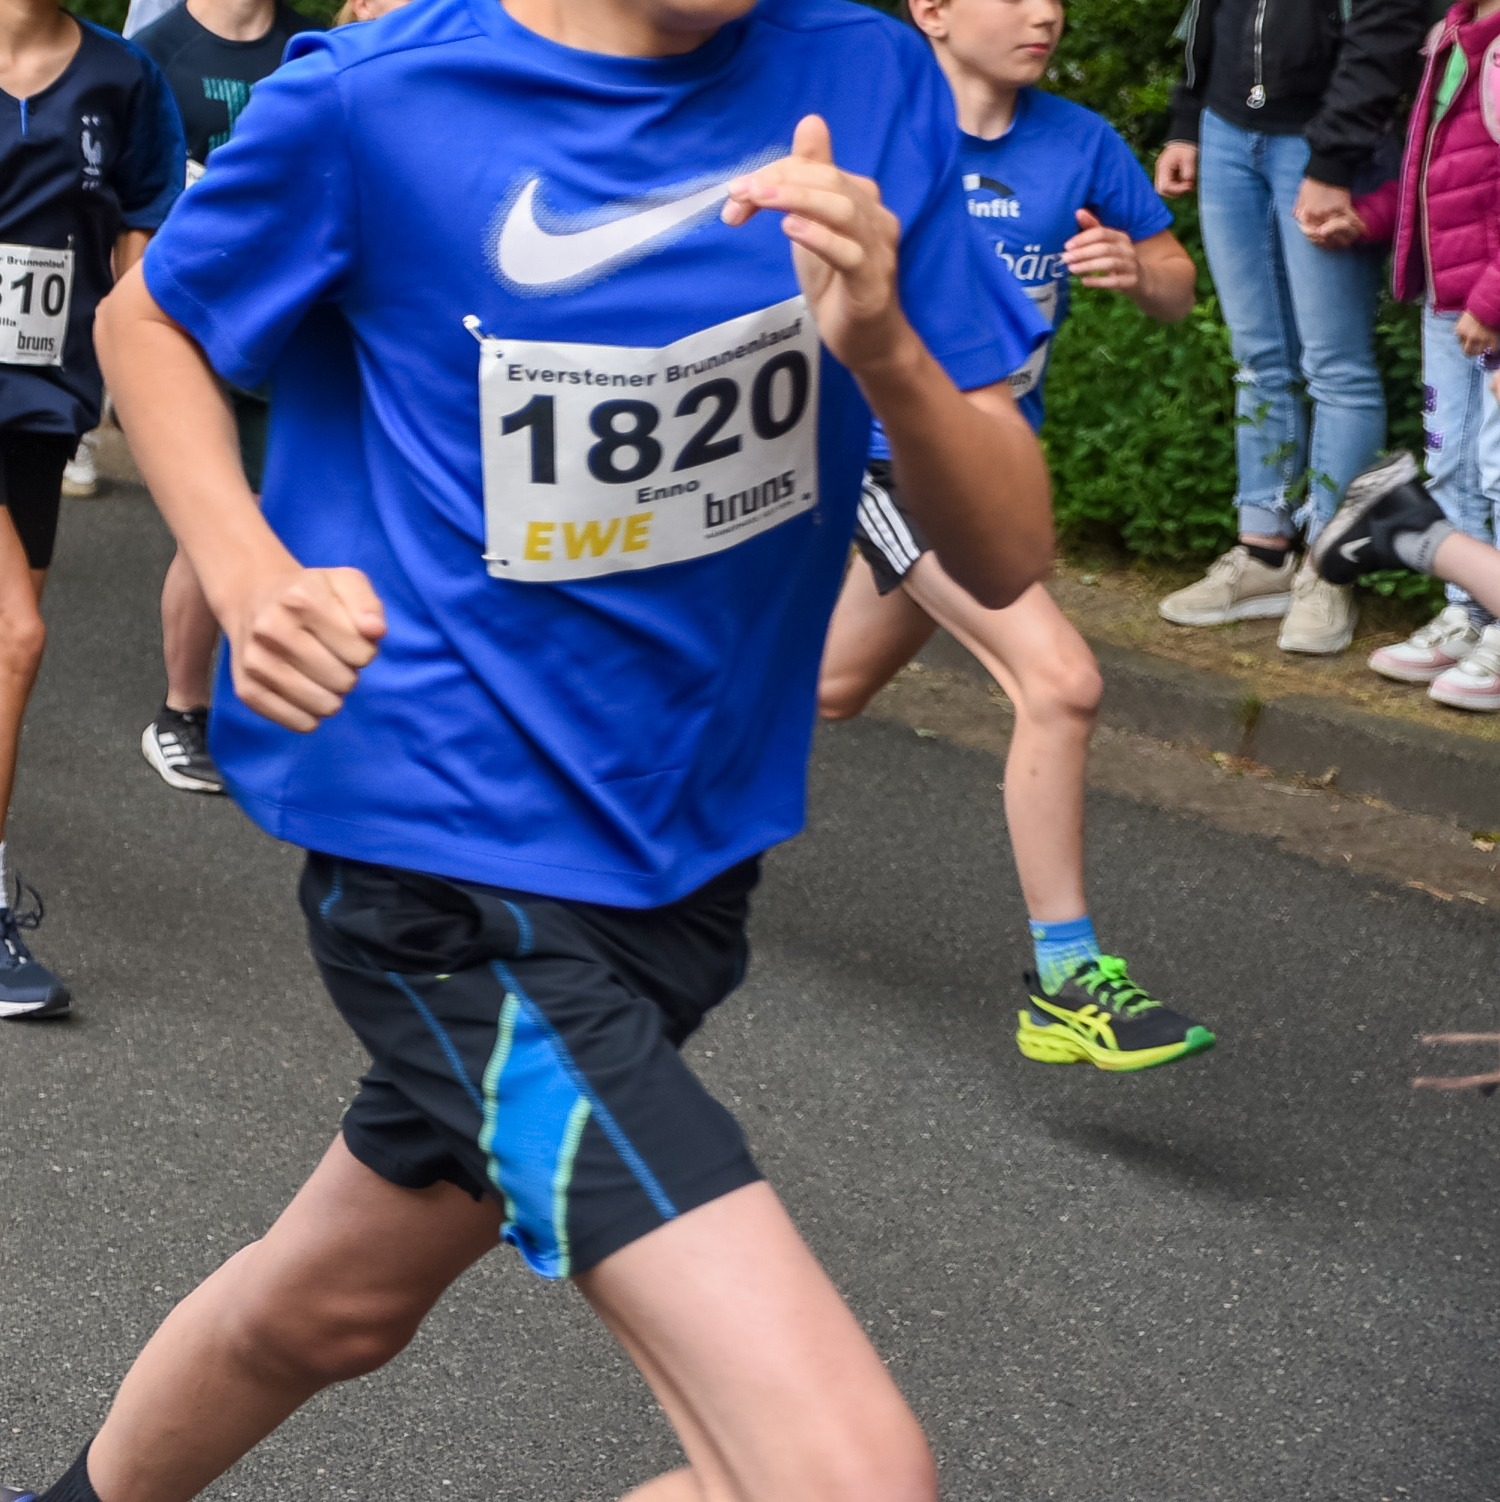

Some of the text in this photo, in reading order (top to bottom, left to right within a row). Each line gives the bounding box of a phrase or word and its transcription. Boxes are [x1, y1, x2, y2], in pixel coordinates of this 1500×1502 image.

[968, 198, 1021, 218] infit
[6, 255, 65, 268] Brunnenlauf
[994, 241, 1065, 281] bäre
[17, 330, 55, 351] bruns
[507, 318, 803, 387] Everstener Brunnenlauf
[501, 350, 811, 485] 1820
[636, 480, 701, 504] Enno
[705, 469, 796, 528] bruns
[523, 512, 654, 561] EWE
